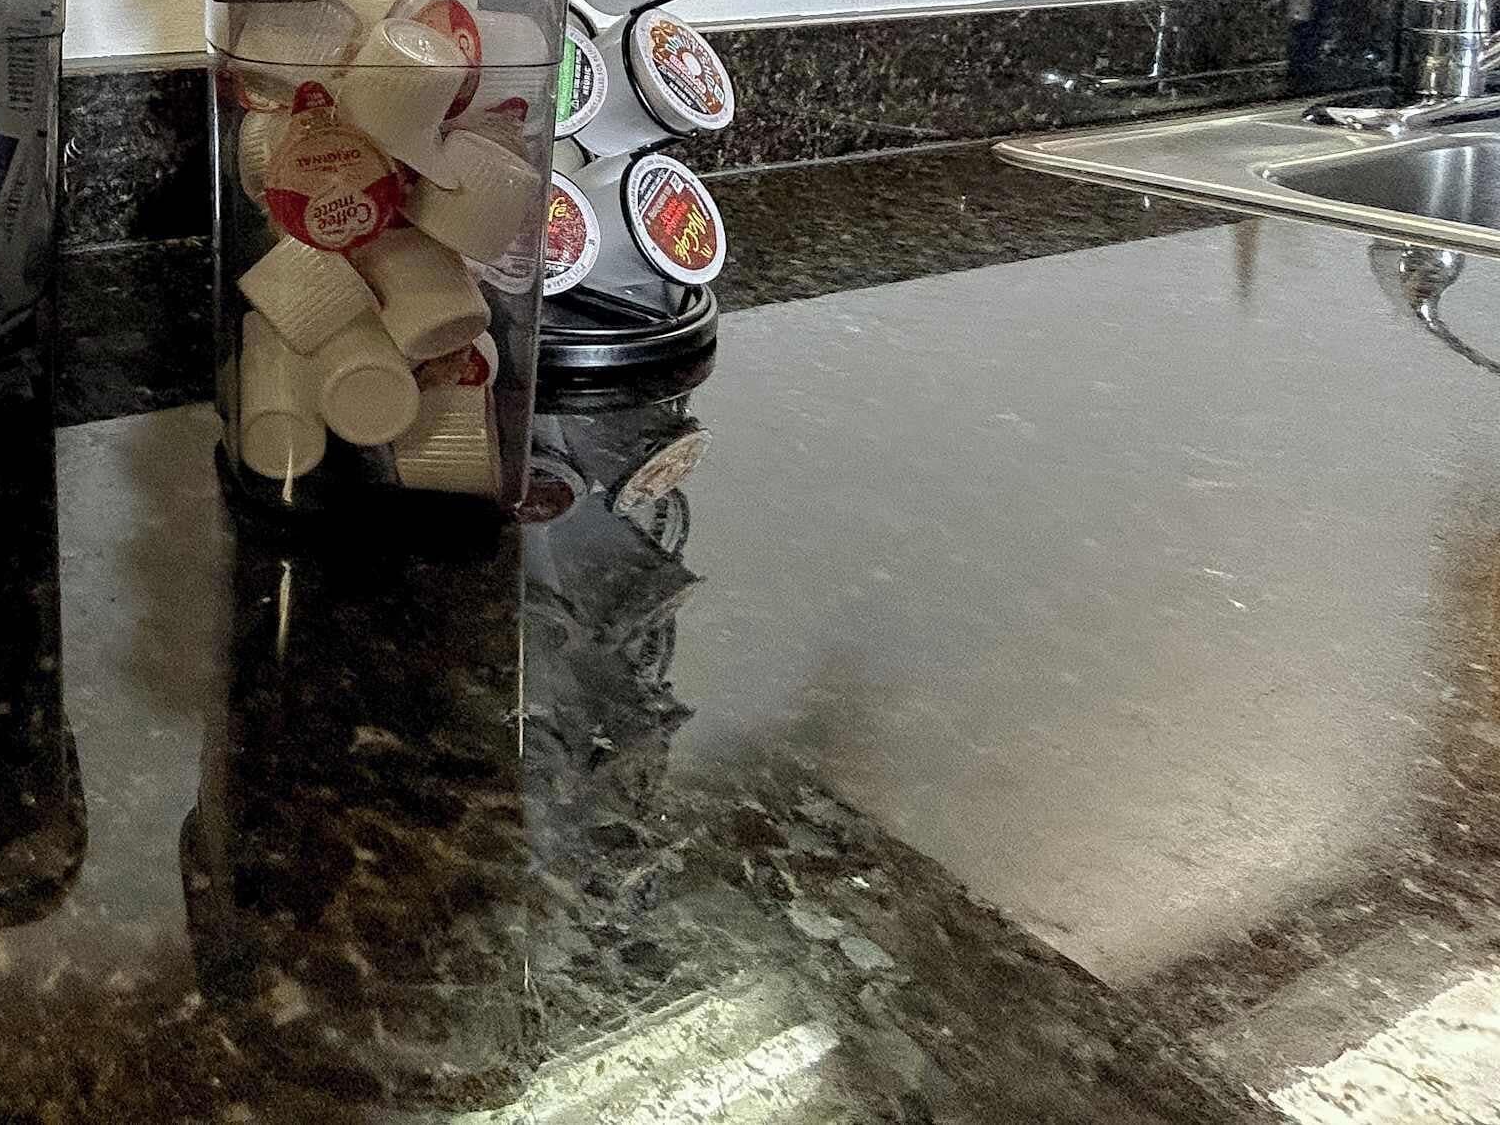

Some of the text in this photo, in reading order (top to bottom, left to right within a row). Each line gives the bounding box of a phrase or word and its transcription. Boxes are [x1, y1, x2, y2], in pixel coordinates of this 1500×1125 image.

[314, 194, 355, 218] mate
[318, 202, 372, 229] Coffee
[673, 203, 707, 265] McCafé
